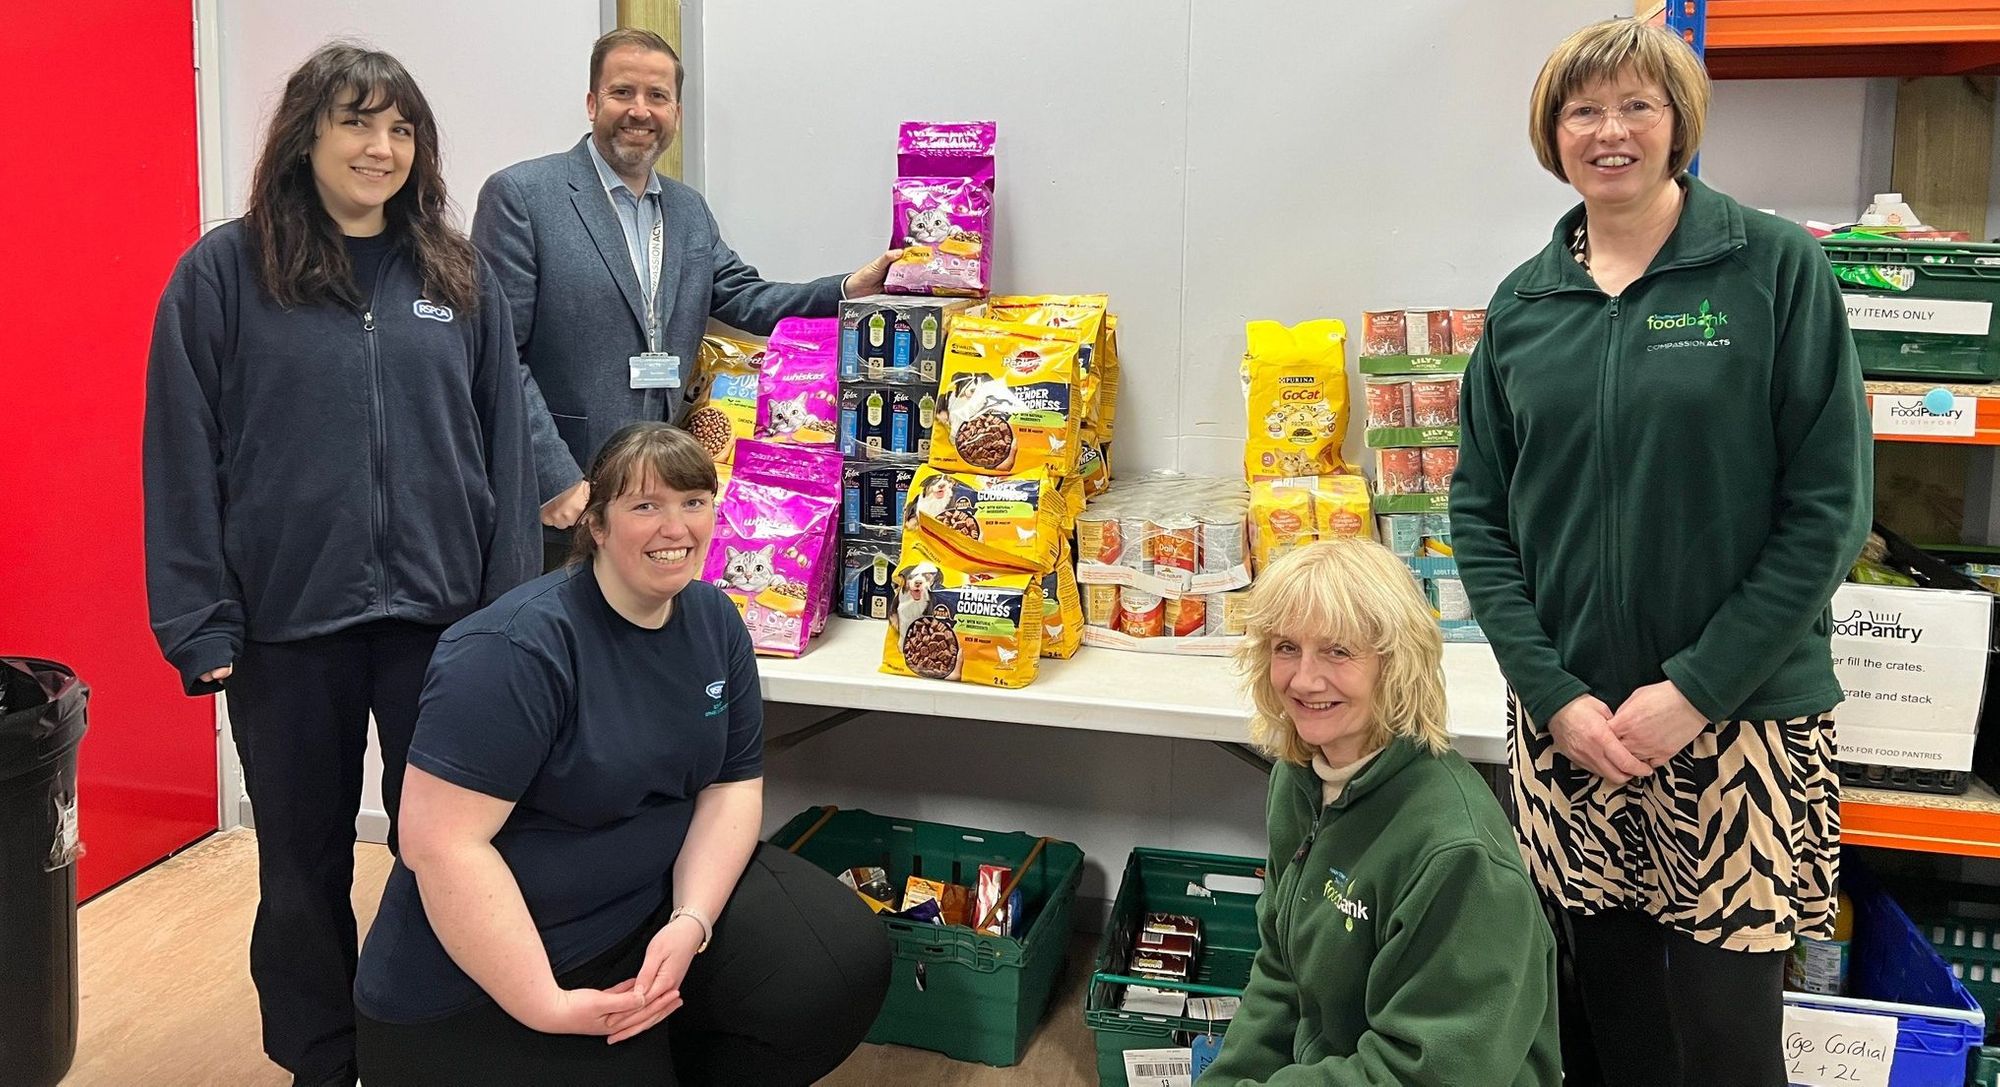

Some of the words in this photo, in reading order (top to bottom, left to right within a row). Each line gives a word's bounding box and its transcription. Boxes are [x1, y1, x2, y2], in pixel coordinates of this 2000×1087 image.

[419, 304, 450, 318] RSPCA
[1864, 308, 1900, 320] ITEMS
[1902, 310, 1935, 320] ONLY
[1646, 340, 1705, 352] COMPASSION
[1706, 338, 1731, 347] ACTS
[1411, 357, 1442, 365] LILY'S
[782, 372, 826, 381] whiskas
[1282, 389, 1320, 400] GoCat
[1422, 429, 1454, 437] LILY'S
[959, 590, 999, 603] TENDER
[957, 601, 1011, 617] GOODNESS
[1848, 656, 1860, 666] fill
[1864, 659, 1882, 669] the
[1886, 661, 1926, 673] crates.
[1843, 689, 1872, 699] crate
[1875, 691, 1898, 702] and
[1901, 694, 1932, 705] stack
[1857, 746, 1874, 755] FOR
[1875, 748, 1900, 757] FOOD
[1902, 751, 1943, 761] PANTRIES
[1825, 1033, 1887, 1062] Cordial
[1834, 1063, 1861, 1081] 2L
